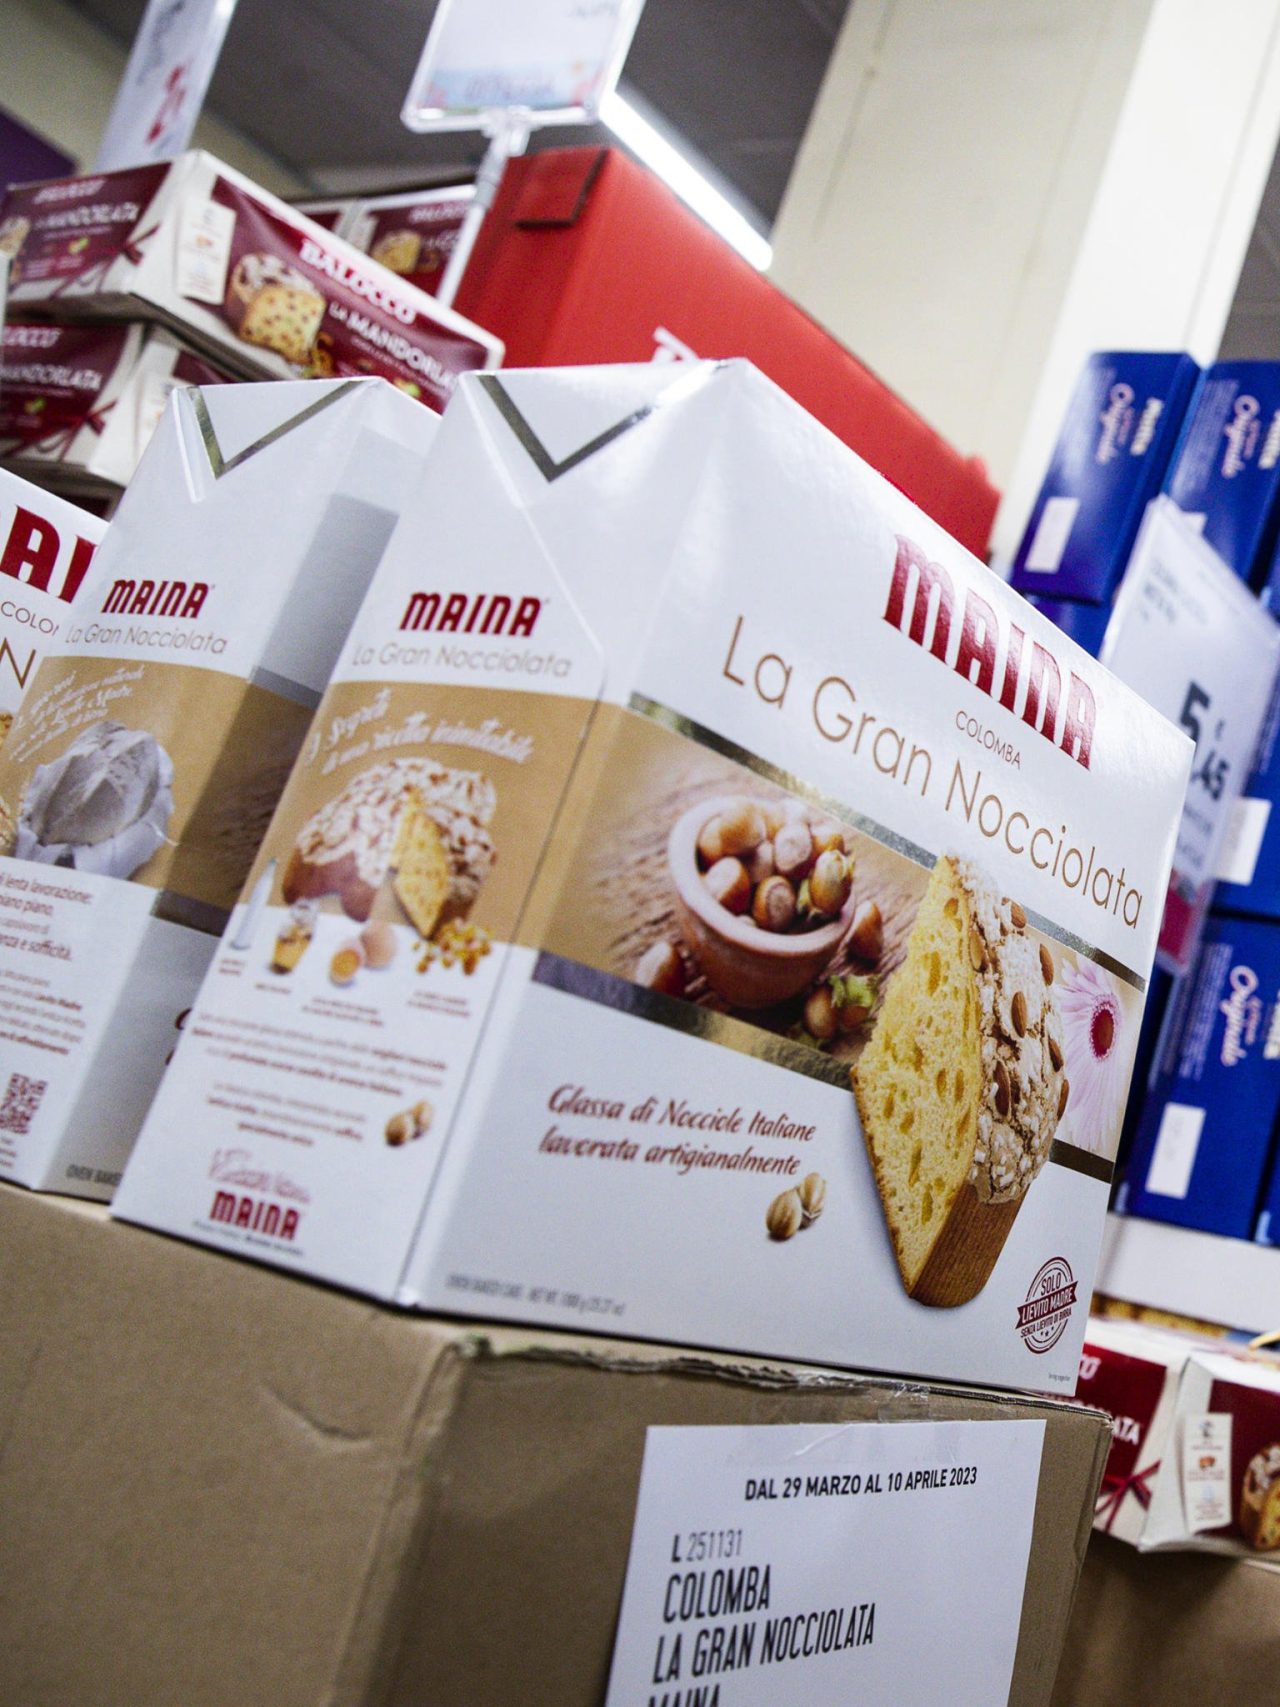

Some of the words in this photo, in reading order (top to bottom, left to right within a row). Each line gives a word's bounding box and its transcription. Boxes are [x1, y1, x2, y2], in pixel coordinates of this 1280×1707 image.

[300, 238, 417, 325] BALOCCO
[101, 579, 209, 619] MAINA
[398, 592, 541, 638] MAINA
[65, 625, 83, 644] La
[85, 623, 122, 644] Gran
[124, 626, 228, 654] Nocciolata
[352, 644, 373, 667] La
[379, 642, 431, 667] Gran
[436, 645, 572, 678] Nocciolata
[881, 533, 1097, 772] MAINA
[955, 710, 1022, 770] COLOMBA
[723, 615, 793, 710] La
[813, 676, 932, 796] Gran
[945, 758, 1144, 930] Nocciolata
[548, 1083, 624, 1119] Glassa
[630, 1095, 656, 1124] di
[658, 1099, 743, 1134] Nocciole
[747, 1110, 817, 1142] Italiane
[539, 1126, 640, 1162] lavorata
[644, 1142, 800, 1177] artigianalmente
[210, 1190, 300, 1241] MAINA
[1022, 1299, 1049, 1324] LIEVITO
[1050, 1286, 1073, 1311] MADRE
[1040, 1272, 1062, 1296] SOLO
[1020, 1324, 1036, 1338] SENZA
[1036, 1315, 1053, 1332] LIEVITO
[745, 1479, 778, 1501] DAL
[782, 1477, 802, 1499] 29
[805, 1474, 861, 1497] MARZO
[864, 1473, 883, 1494] AL
[888, 1471, 903, 1492] 10
[904, 1468, 948, 1491] APRILE
[949, 1466, 978, 1487] 2023
[671, 1534, 682, 1563] L
[686, 1529, 743, 1563] 251131
[662, 1564, 771, 1624] COLOMBA
[652, 1632, 683, 1685] LA
[691, 1621, 757, 1678] GRAN
[759, 1602, 876, 1665] NOCCIOLATA
